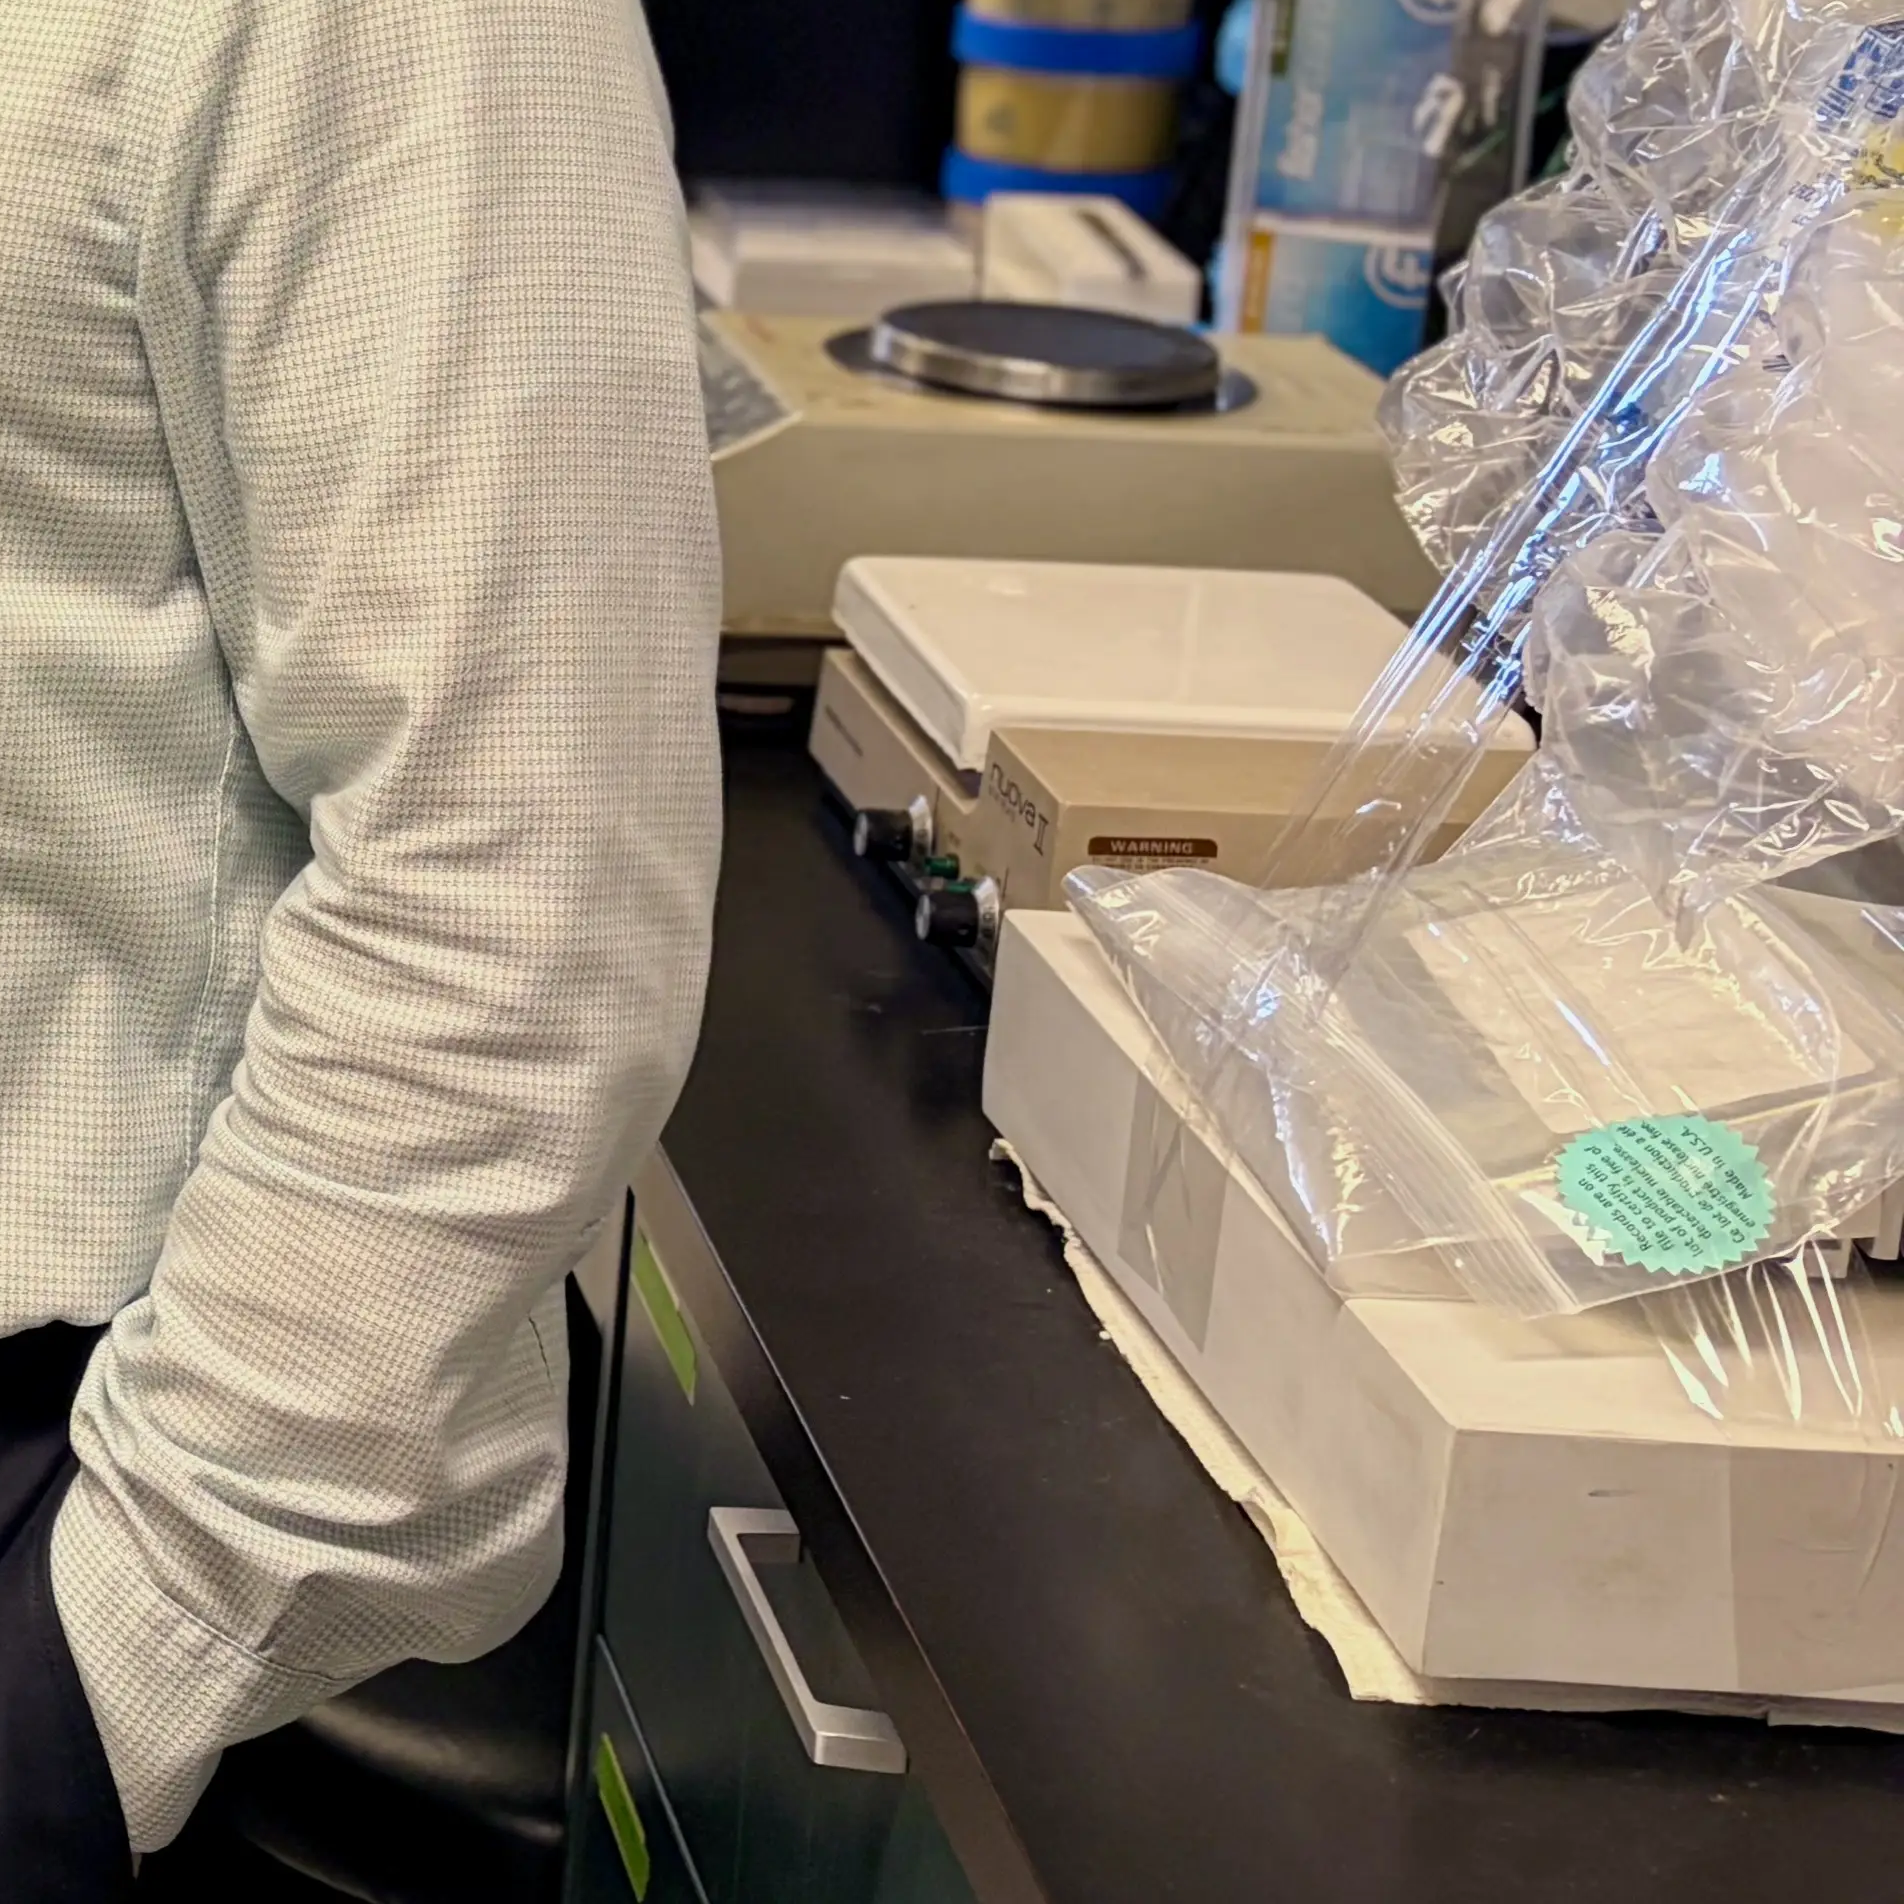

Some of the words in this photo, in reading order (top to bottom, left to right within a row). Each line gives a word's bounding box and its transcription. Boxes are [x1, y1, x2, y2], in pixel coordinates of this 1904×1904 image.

[1110, 840, 1194, 854] WARNING
[1681, 1126, 1713, 1156] U.S.A.
[1584, 1146, 1602, 1155] of
[1601, 1156, 1624, 1174] free
[1712, 1156, 1726, 1170] in
[1586, 1164, 1608, 1182] this
[1622, 1175, 1634, 1185] is
[1578, 1178, 1594, 1191] on
[1724, 1170, 1752, 1199] Made
[1593, 1192, 1613, 1208] are
[1607, 1184, 1645, 1215] certify
[1632, 1187, 1677, 1224] product
[1698, 1200, 1714, 1211] de
[1656, 1188, 1712, 1239] detectable
[1712, 1212, 1732, 1228] lot
[1611, 1209, 1653, 1252] Records
[1641, 1217, 1656, 1230] to
[1669, 1225, 1687, 1237] of
[1655, 1230, 1674, 1251] file
[1730, 1228, 1745, 1243] Ce
[1684, 1237, 1703, 1257] lot
